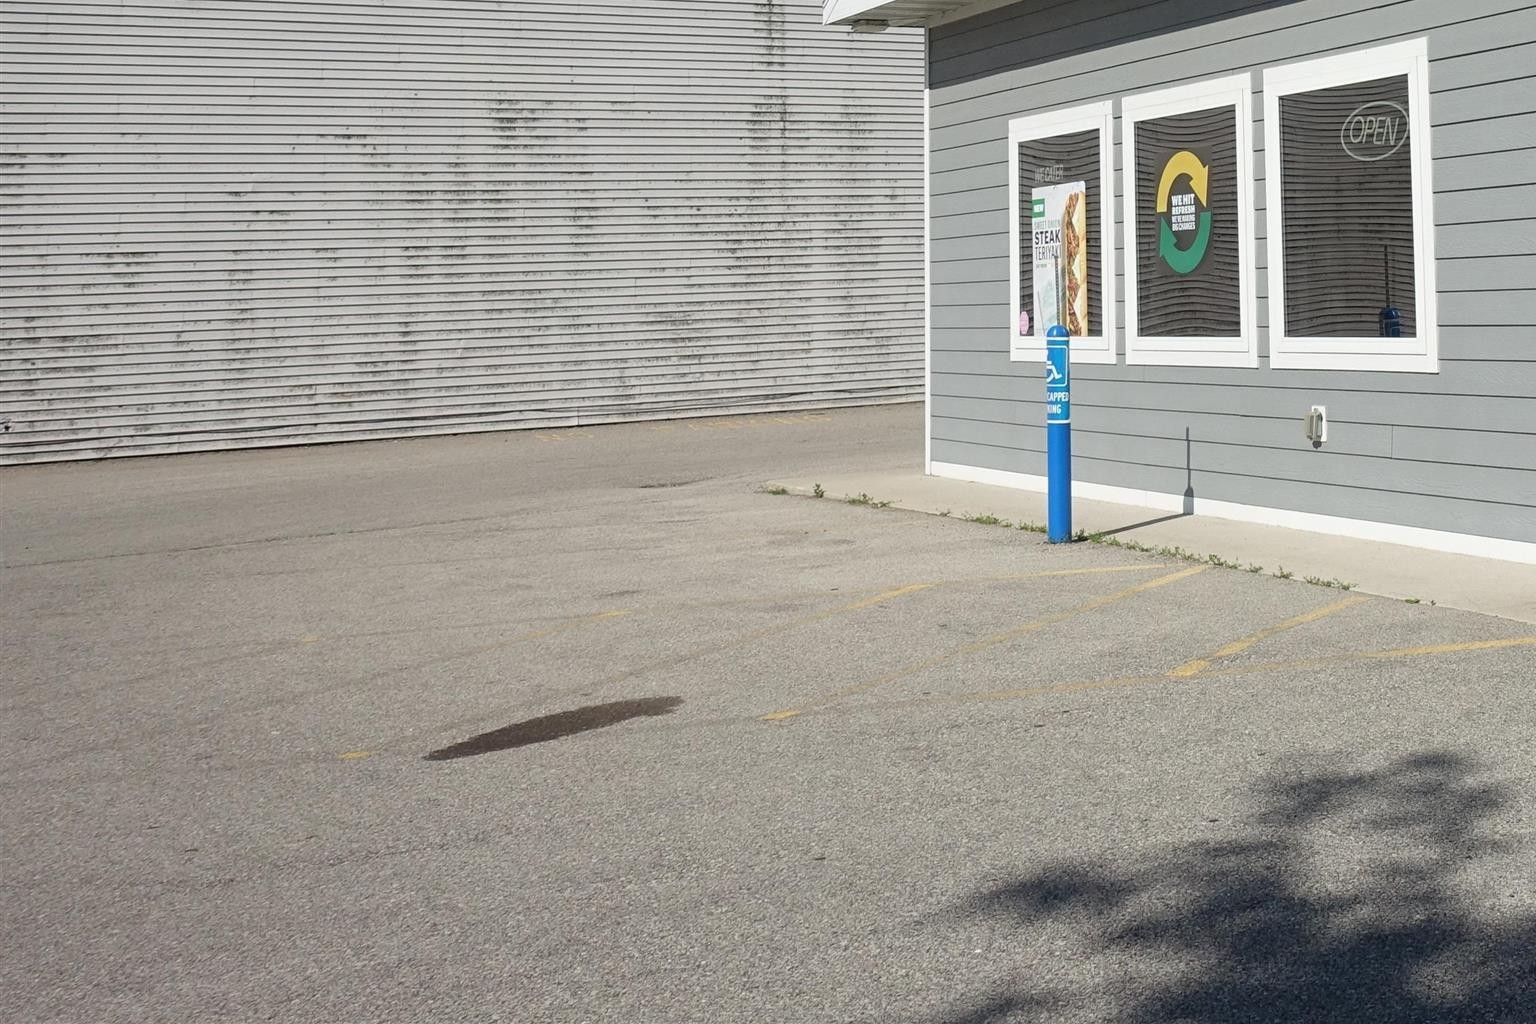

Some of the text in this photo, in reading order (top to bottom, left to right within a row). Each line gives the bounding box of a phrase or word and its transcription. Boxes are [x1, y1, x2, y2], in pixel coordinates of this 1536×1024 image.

[1350, 116, 1400, 146] OPEN
[1171, 193, 1195, 206] WE HIT
[1034, 229, 1061, 245] STEAK
[1047, 391, 1069, 402] CAPPED
